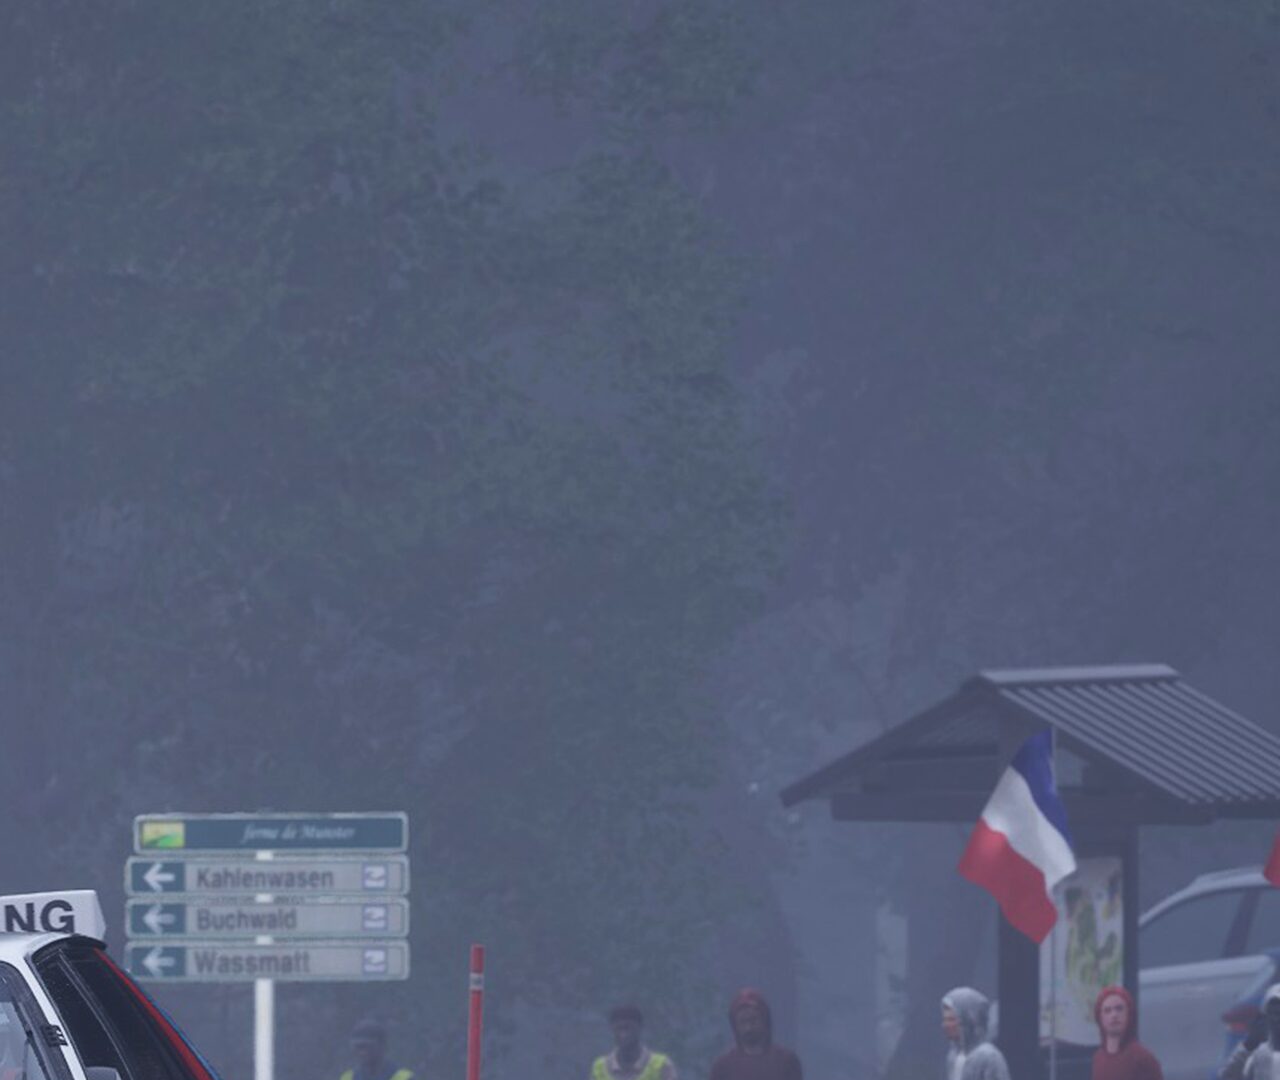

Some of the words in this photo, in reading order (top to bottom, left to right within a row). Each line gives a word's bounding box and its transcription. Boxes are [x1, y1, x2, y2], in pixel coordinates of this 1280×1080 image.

[196, 867, 334, 890] Kahlenwasen
[196, 908, 297, 931] Buchwald
[195, 951, 312, 975] Wassmatt
